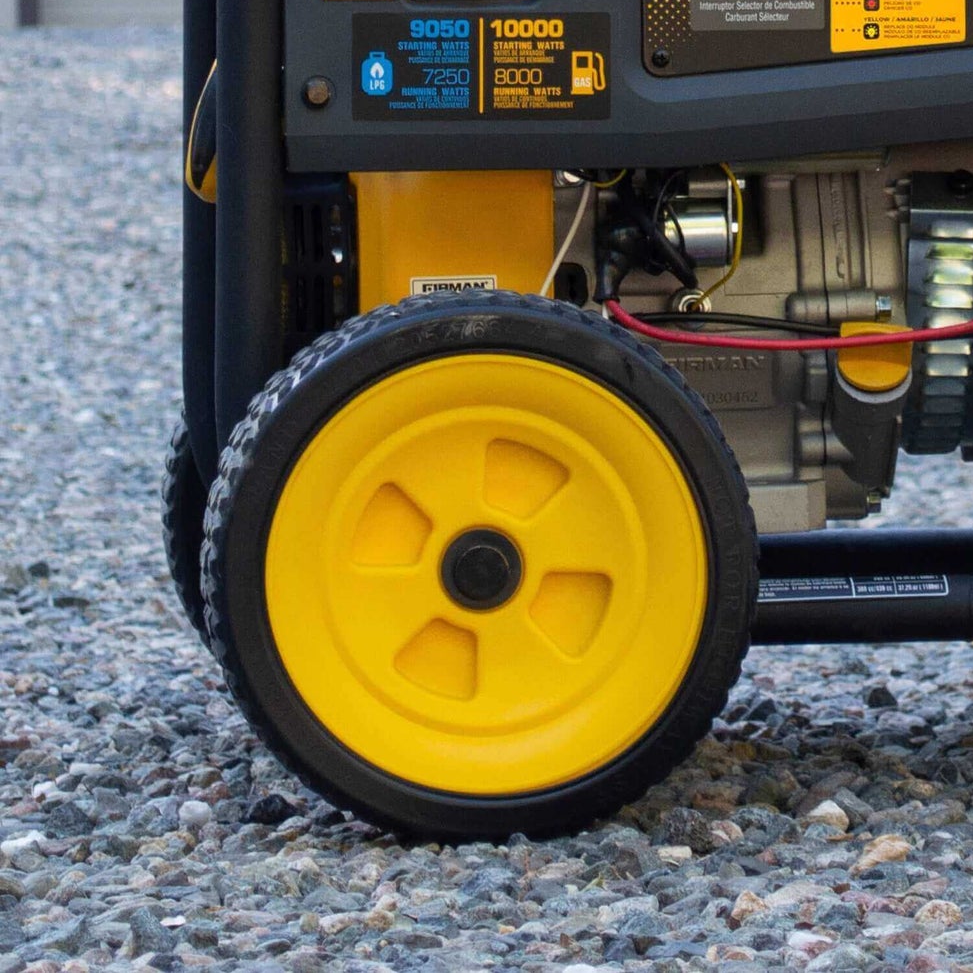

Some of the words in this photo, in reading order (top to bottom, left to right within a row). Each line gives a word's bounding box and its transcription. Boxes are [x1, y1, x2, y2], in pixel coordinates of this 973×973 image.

[700, 1, 735, 11] Interruptor
[736, 1, 763, 10] Selector
[764, 1, 772, 10] de
[774, 0, 815, 9] Combustible
[725, 12, 757, 22] Carburant
[410, 19, 470, 38] 9050
[490, 19, 564, 38] 10000
[398, 41, 437, 50] STARTING
[441, 41, 470, 50] WATTS
[493, 41, 532, 50] STARTING
[537, 41, 565, 50] WATTS
[422, 68, 470, 85] 7250
[495, 68, 542, 85] 8000
[369, 79, 385, 90] LPG
[574, 78, 591, 88] GAS
[401, 87, 437, 96] RUNNING
[441, 87, 470, 96] WATTS
[494, 87, 529, 96] RUNNING
[533, 87, 561, 96] WATTS
